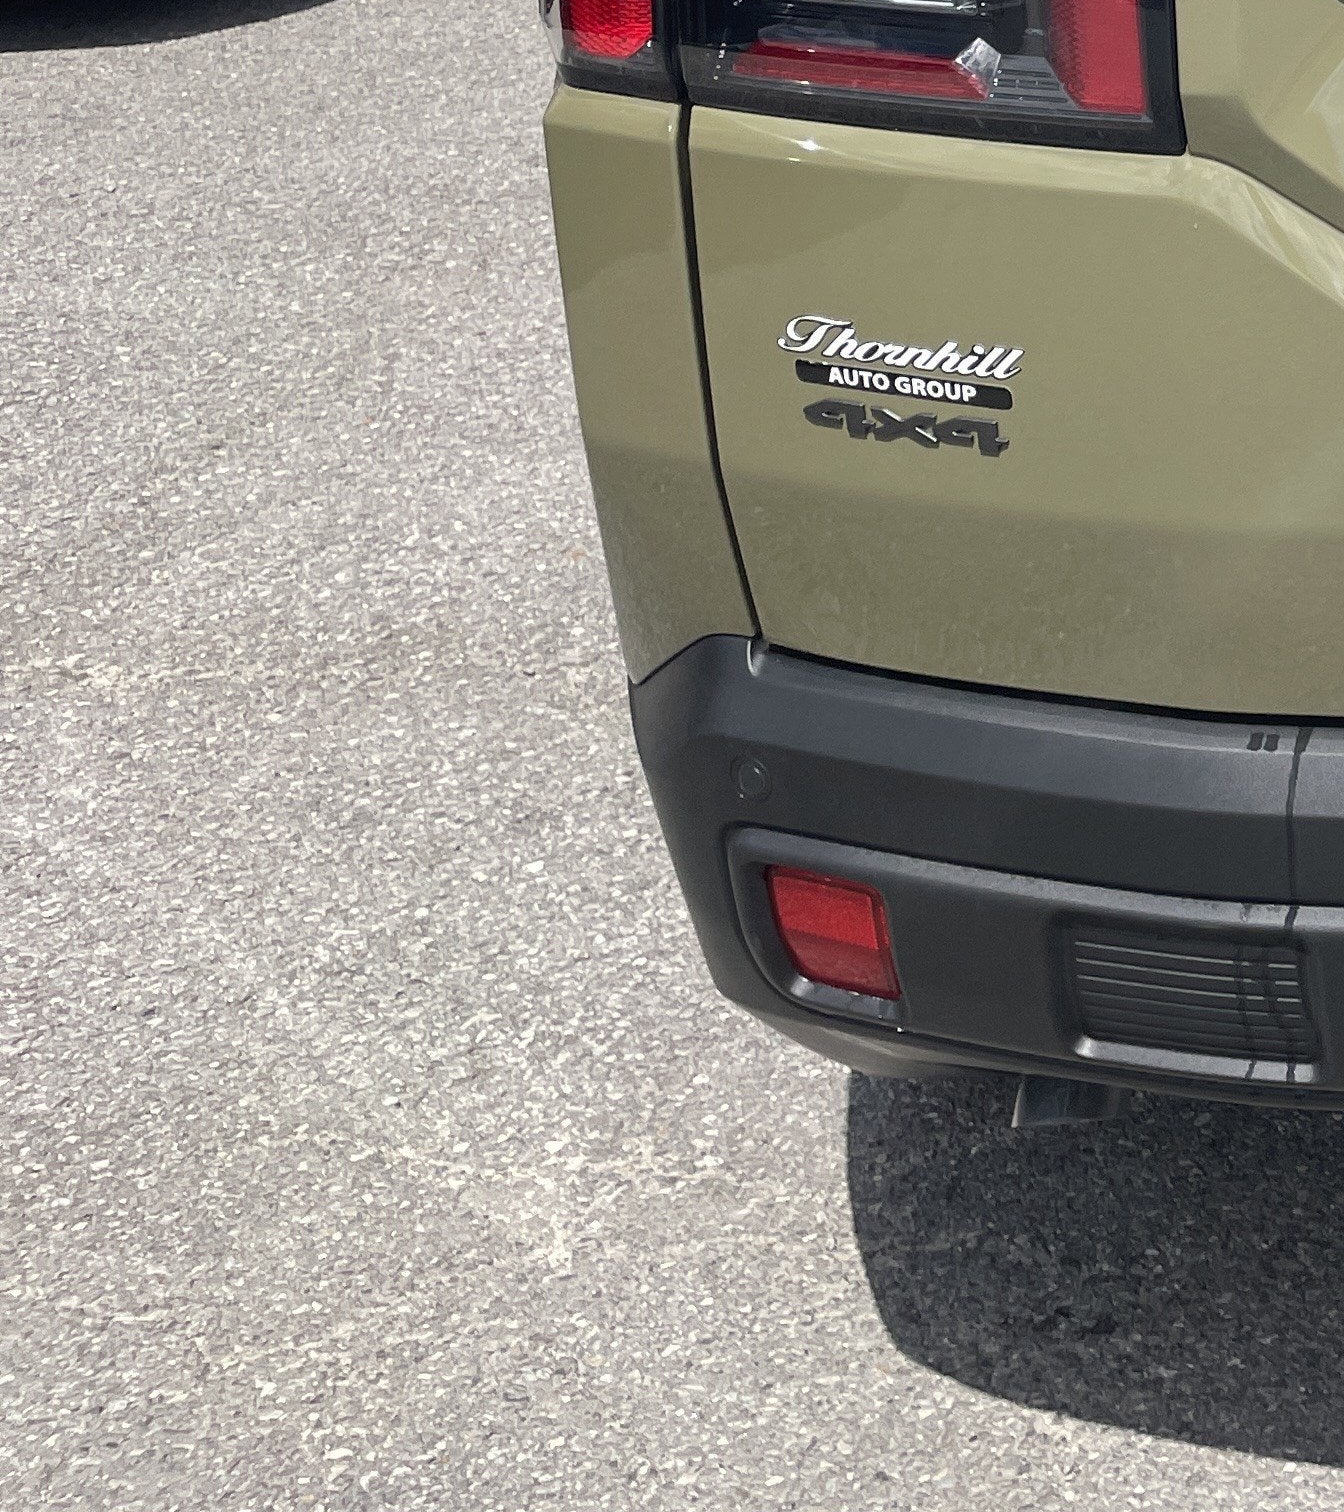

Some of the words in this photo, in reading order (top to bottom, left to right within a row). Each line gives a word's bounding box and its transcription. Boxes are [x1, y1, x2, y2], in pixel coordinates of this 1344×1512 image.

[777, 314, 1025, 381] Thornhill
[828, 365, 891, 392] AUTO
[894, 375, 977, 403] GROUP
